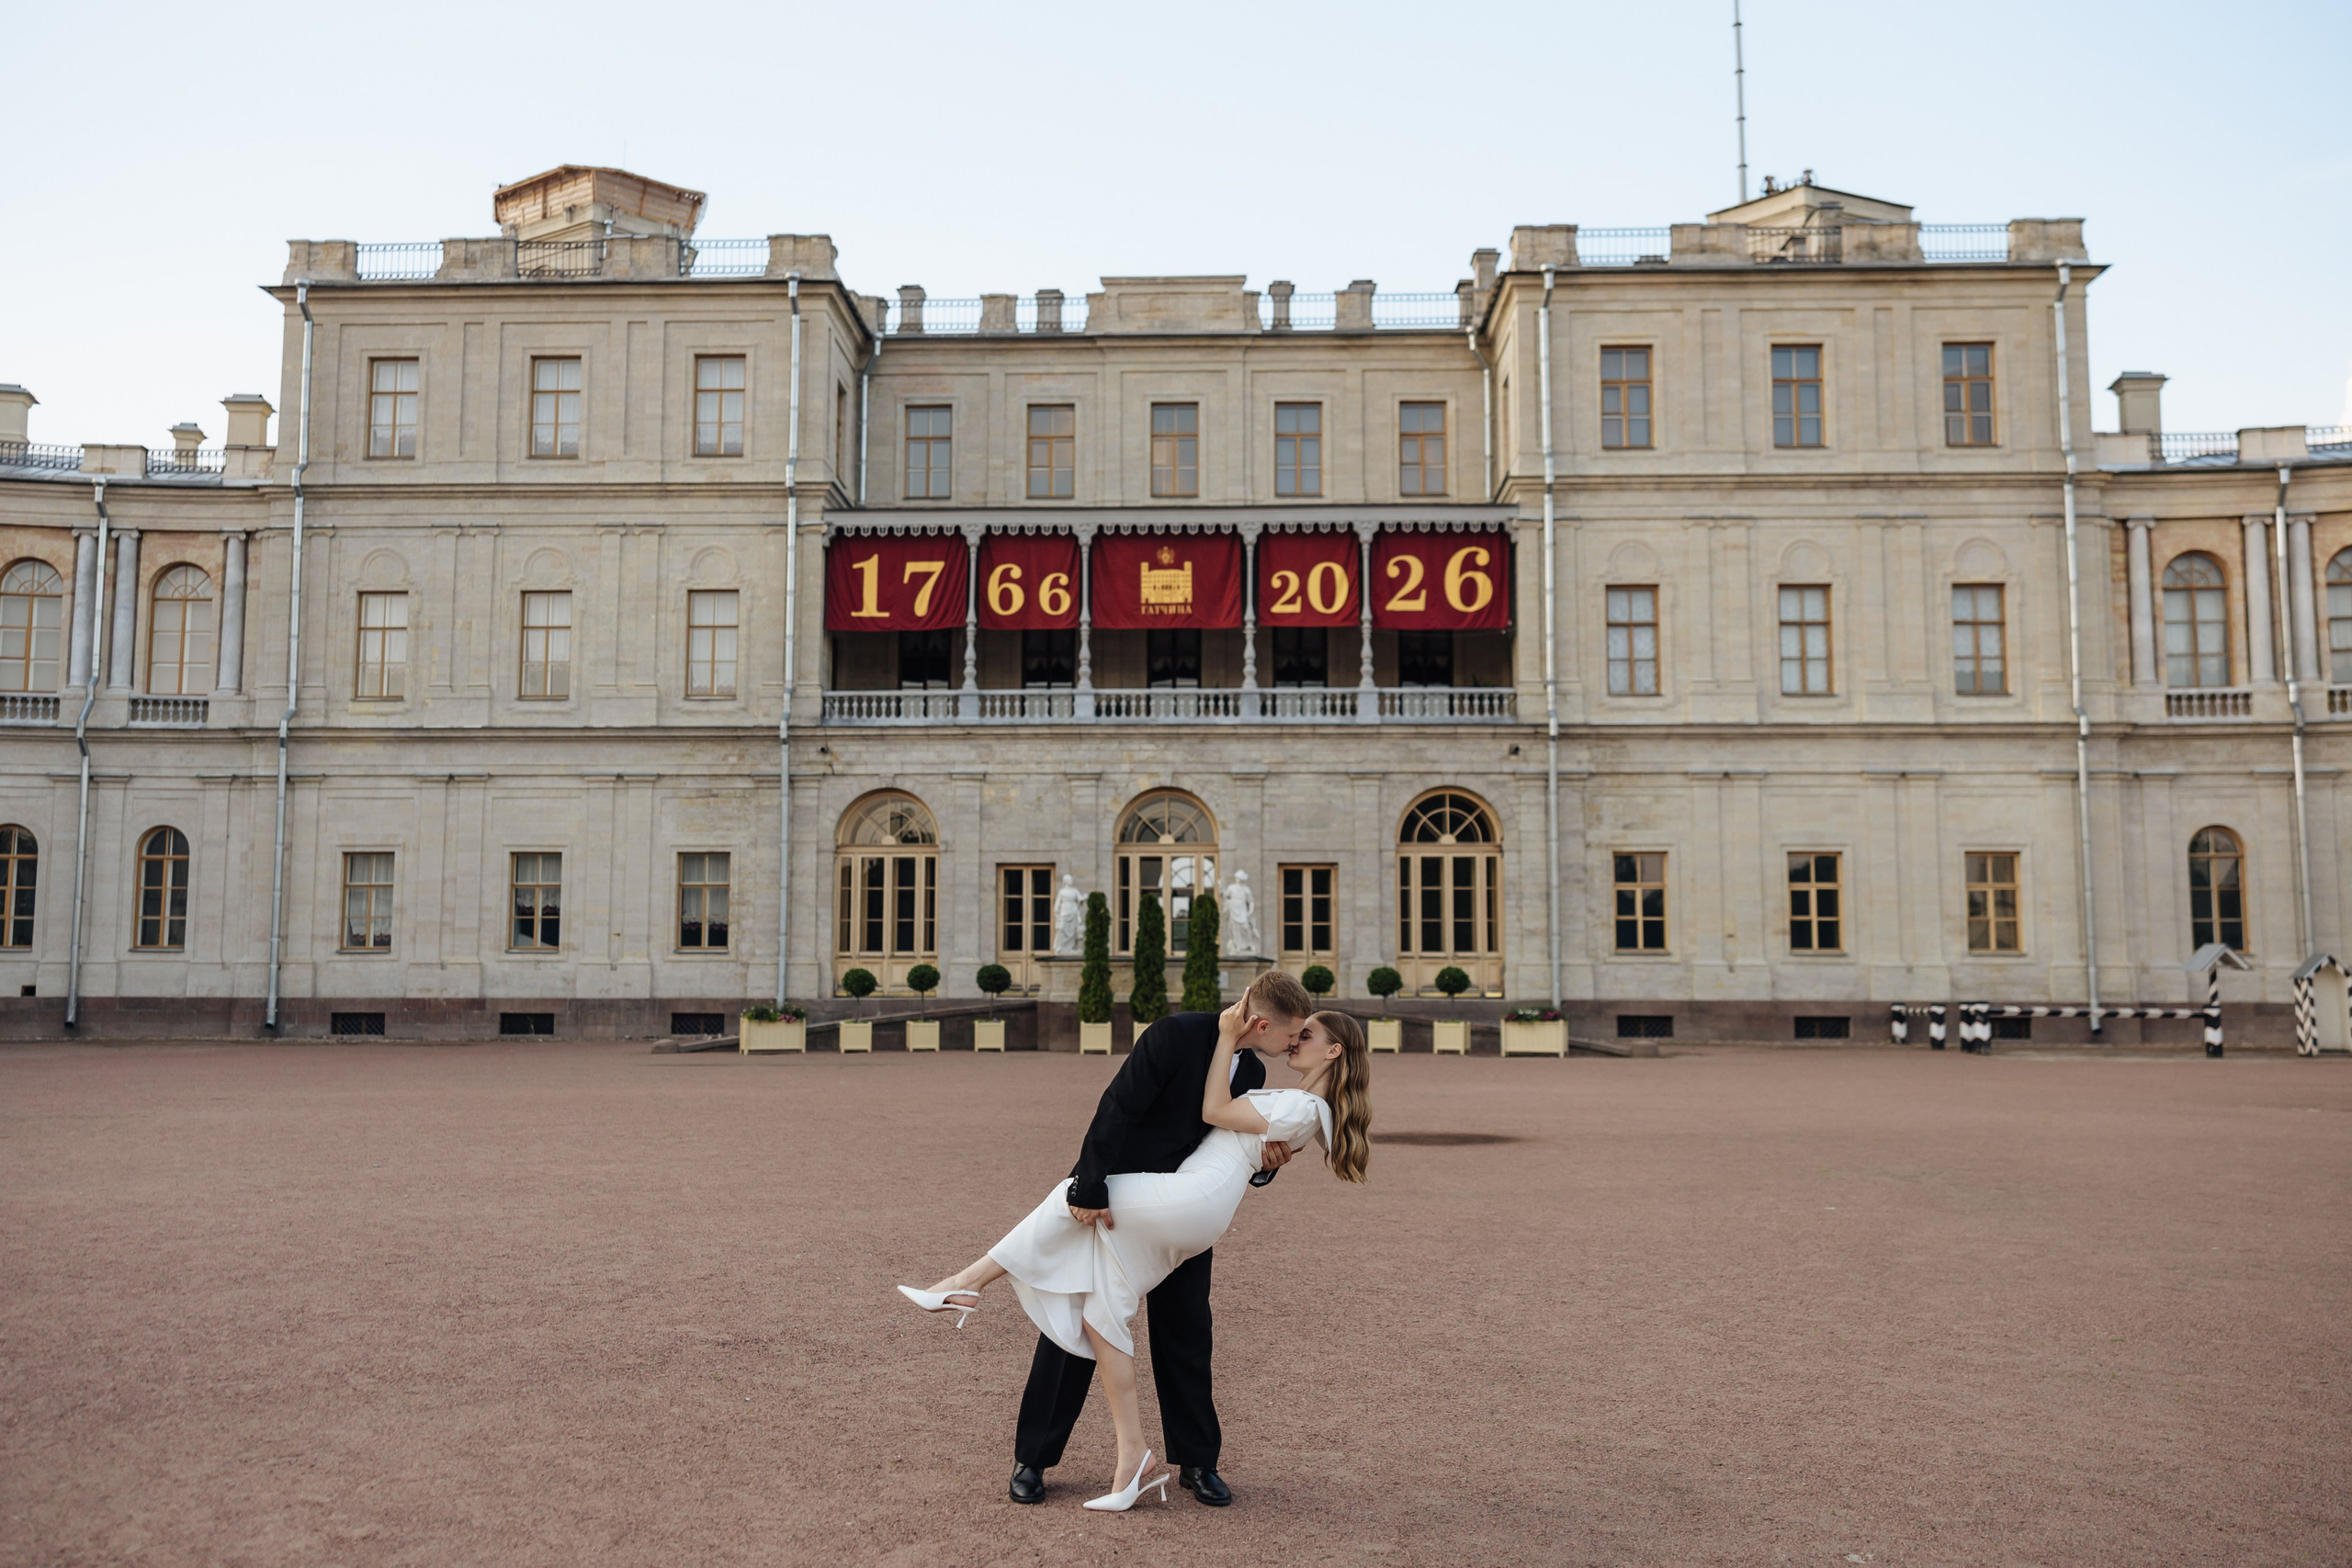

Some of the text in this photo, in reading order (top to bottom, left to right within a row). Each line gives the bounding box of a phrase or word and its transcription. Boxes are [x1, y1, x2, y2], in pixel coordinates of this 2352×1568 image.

[852, 554, 945, 617] 17
[988, 563, 1071, 615] 66
[1270, 561, 1349, 615] 20
[1385, 547, 1493, 613] 26
[1140, 604, 1193, 615] ГАТЧИНА
